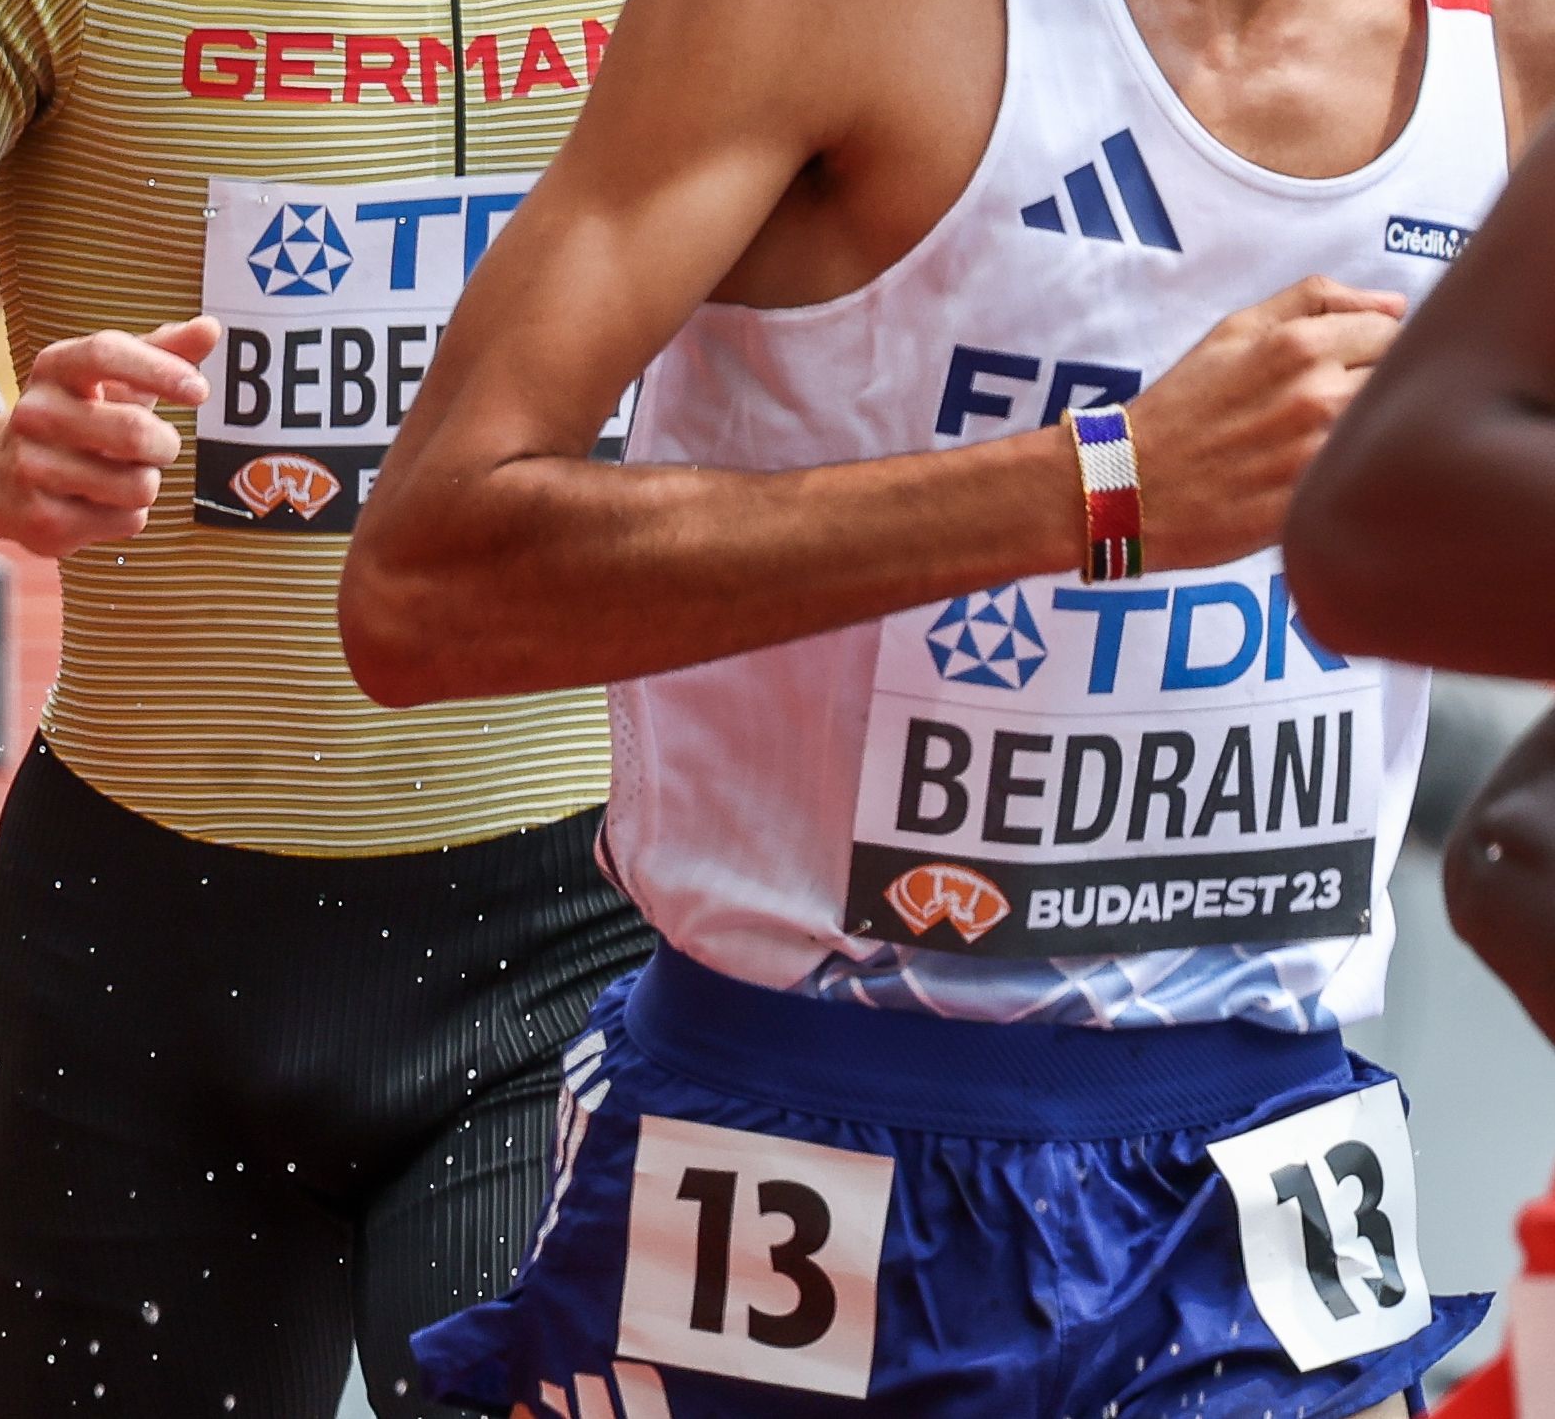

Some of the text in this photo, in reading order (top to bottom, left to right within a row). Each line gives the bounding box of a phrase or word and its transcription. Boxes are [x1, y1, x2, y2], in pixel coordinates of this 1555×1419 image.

[1387, 221, 1446, 258] Crédit
[895, 710, 1354, 849] BEDRANI
[1026, 868, 1343, 932] BUDAPEST 23
[676, 1165, 839, 1350] 13
[1275, 1137, 1407, 1323] 13
